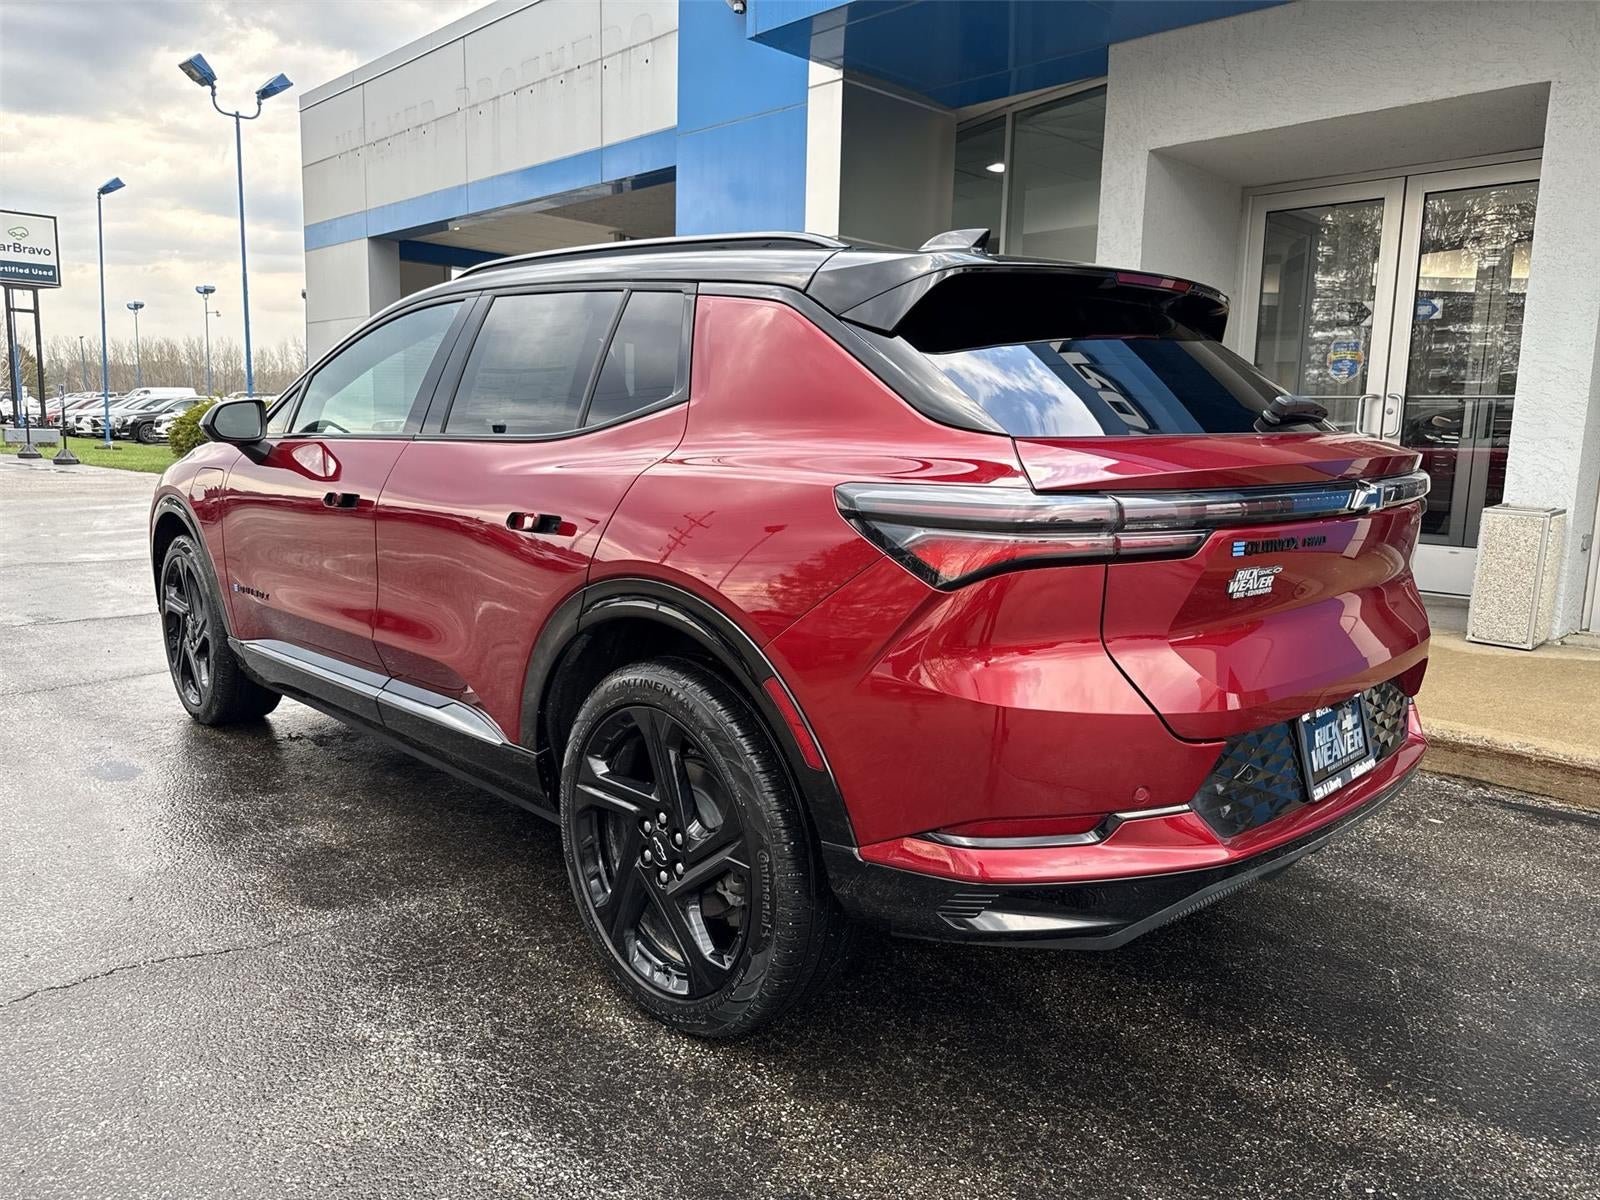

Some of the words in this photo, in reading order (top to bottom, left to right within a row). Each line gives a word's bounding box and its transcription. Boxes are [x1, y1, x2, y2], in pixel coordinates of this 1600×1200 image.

[0, 242, 51, 256] arBravo
[0, 265, 29, 274] rtified
[31, 268, 53, 276] Used
[1235, 567, 1259, 581] RICK
[1228, 575, 1275, 594] WEAVER
[1314, 720, 1340, 748] RICK
[1311, 727, 1364, 773] WEAVER
